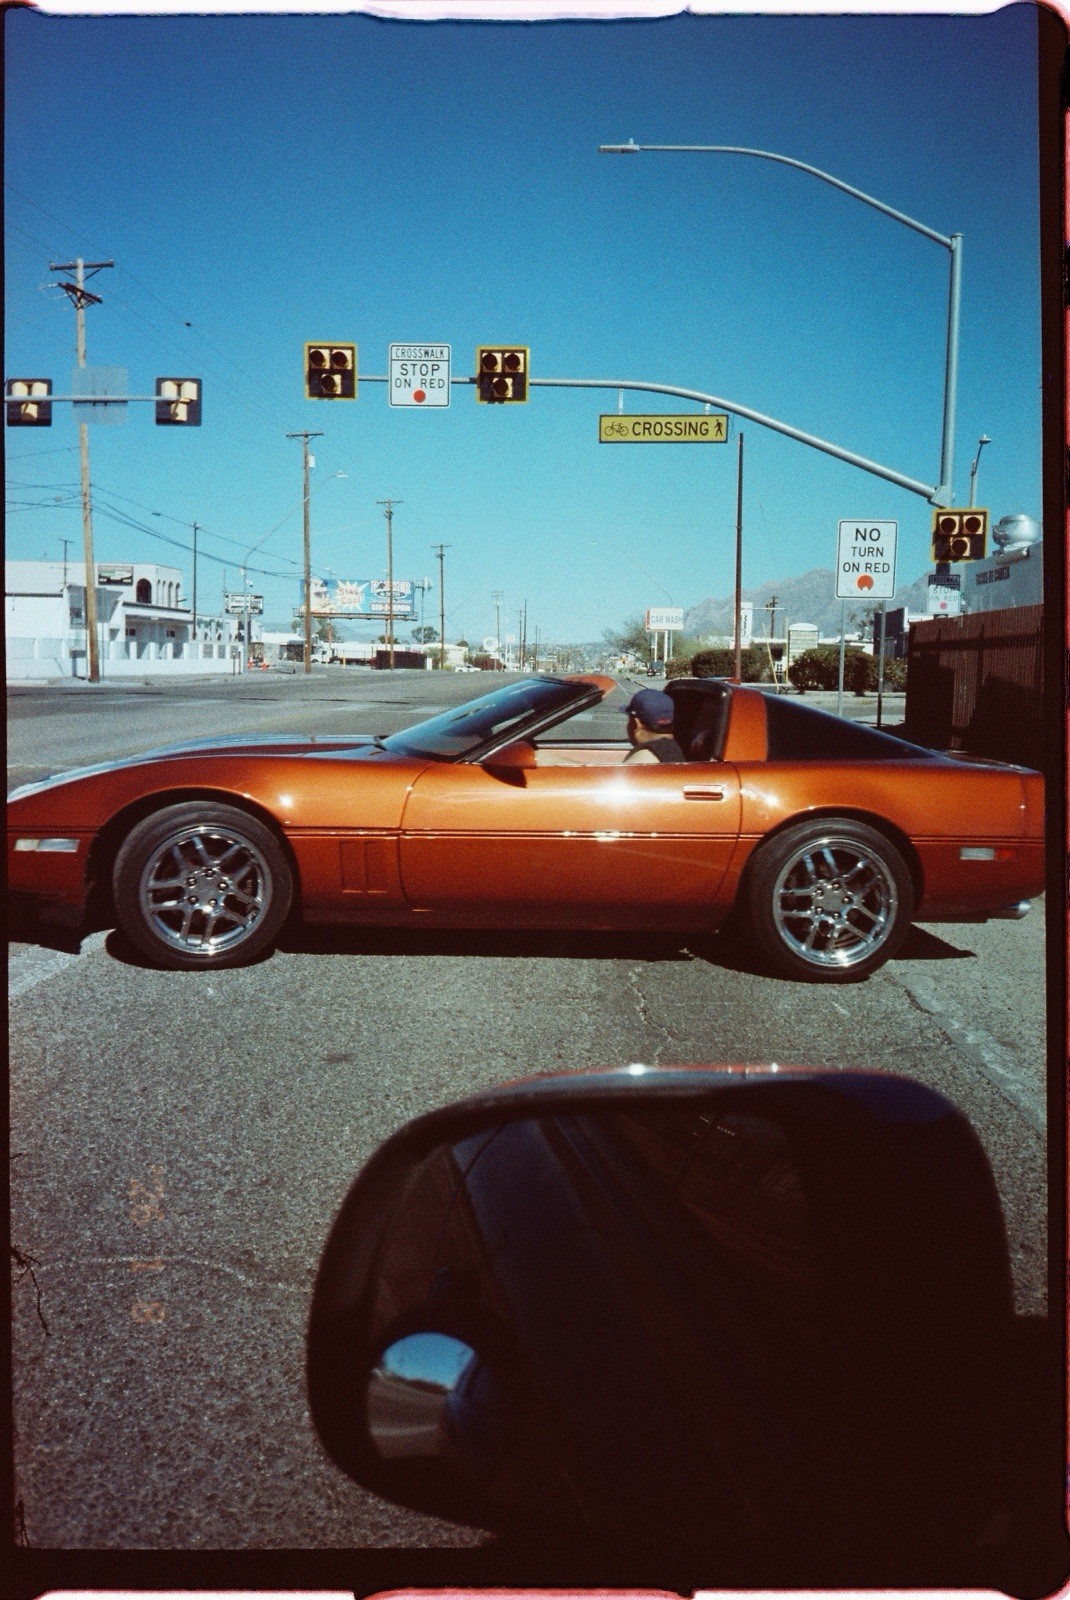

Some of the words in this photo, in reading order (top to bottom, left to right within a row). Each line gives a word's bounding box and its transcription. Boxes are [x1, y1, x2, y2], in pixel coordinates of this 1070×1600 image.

[395, 348, 445, 359] CROSSWALK
[400, 363, 440, 376] STOP
[394, 378, 411, 388] ON
[420, 378, 445, 389] RED
[632, 421, 709, 437] CROSSING
[855, 528, 881, 541] NO
[852, 546, 884, 558] TURN
[842, 562, 860, 573] ON
[865, 562, 891, 573] RED
[651, 615, 664, 624] CAR
[665, 615, 683, 624] WASH
